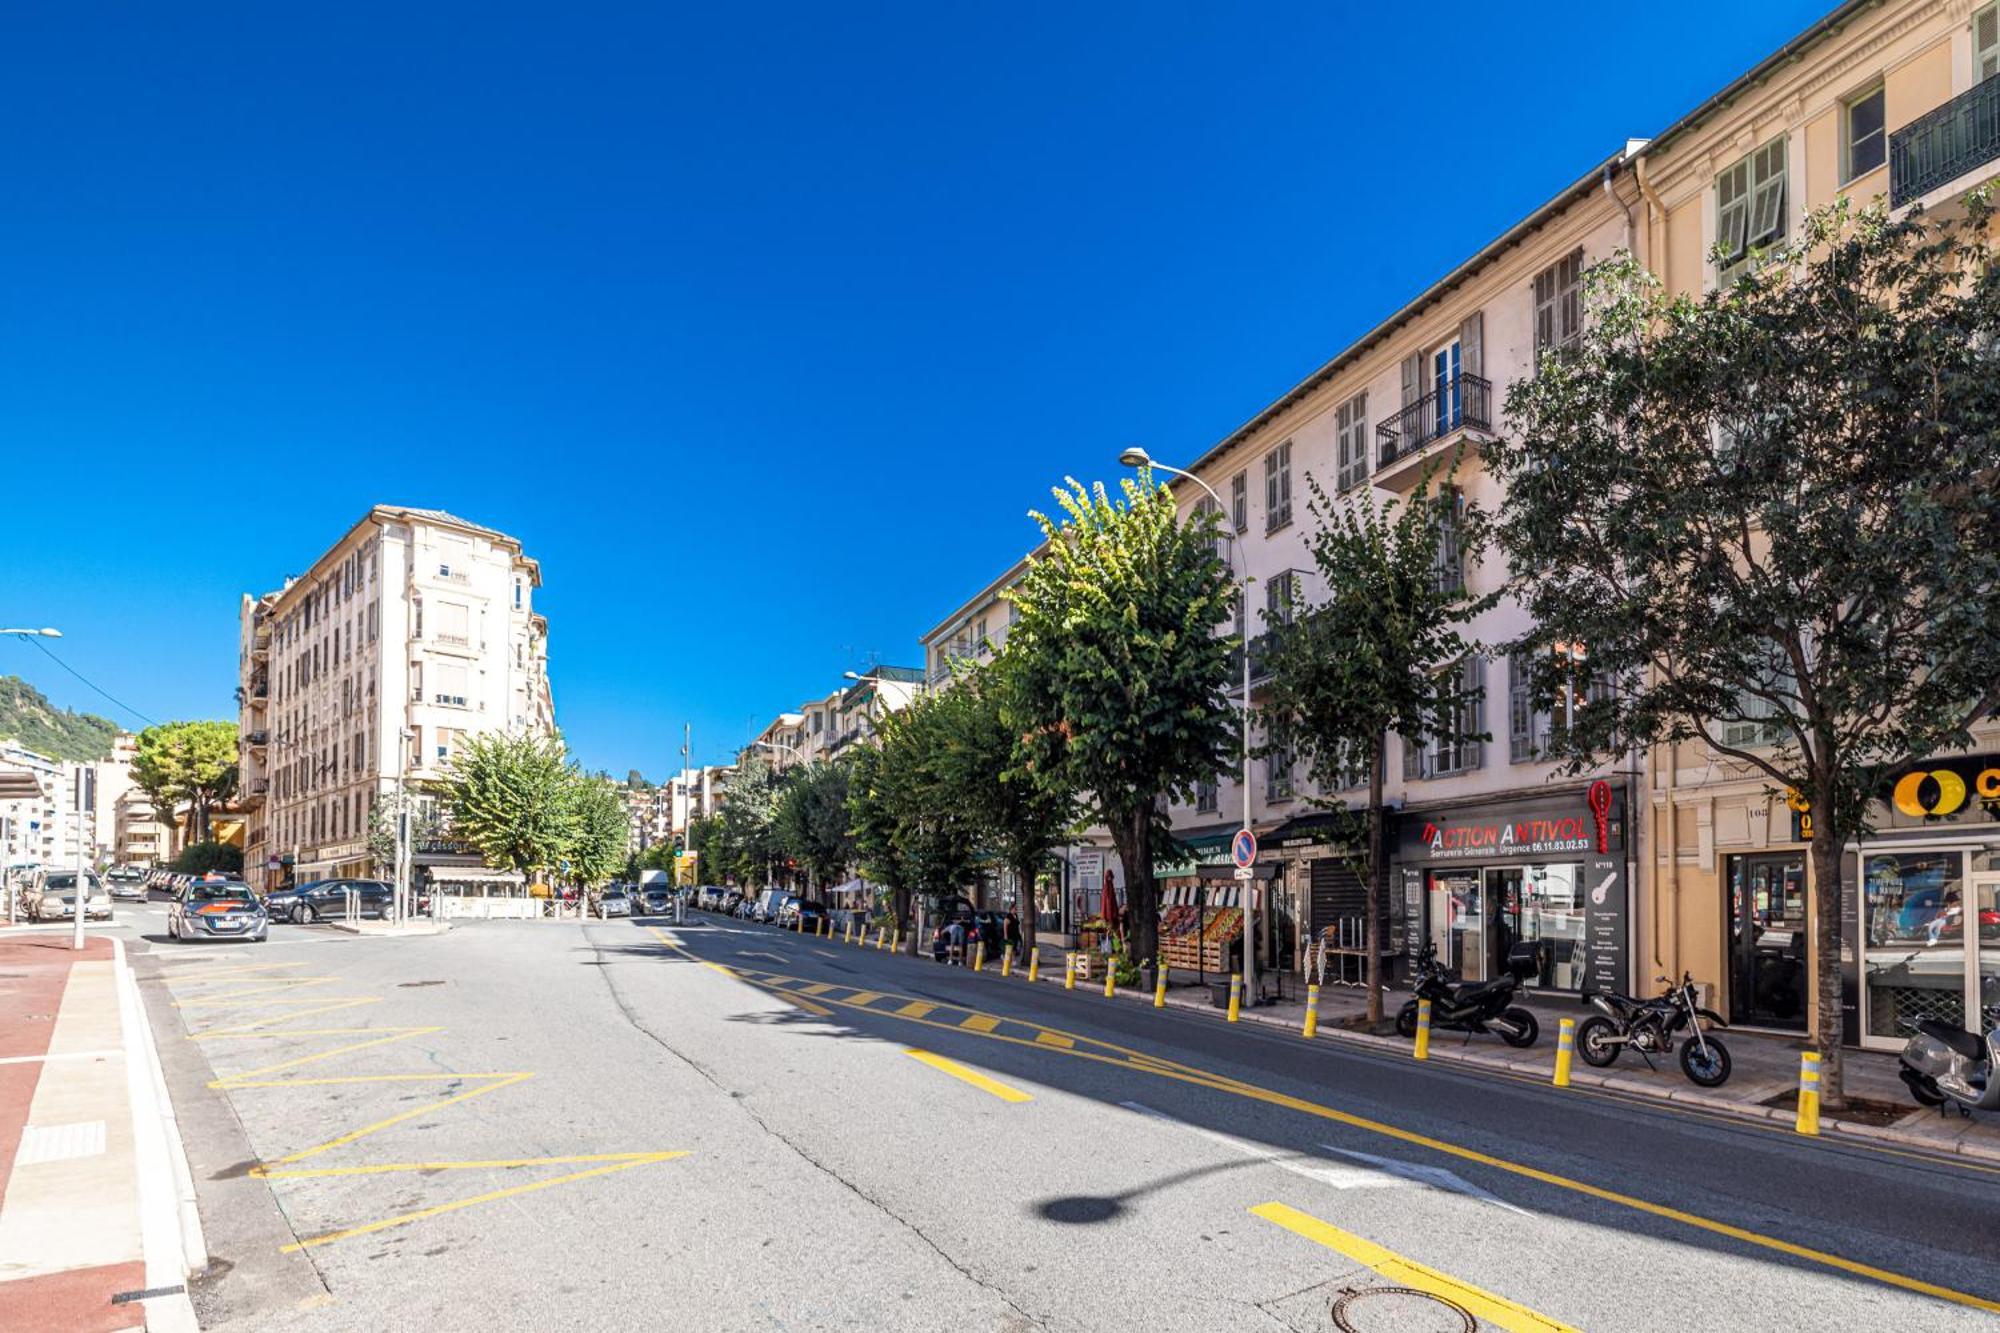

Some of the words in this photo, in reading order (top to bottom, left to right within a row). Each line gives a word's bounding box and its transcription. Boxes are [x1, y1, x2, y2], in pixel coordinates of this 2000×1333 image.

[1431, 825, 1498, 848] ACTION
[1500, 816, 1590, 845] ANTIVOL
[1500, 844, 1531, 855] Urgence
